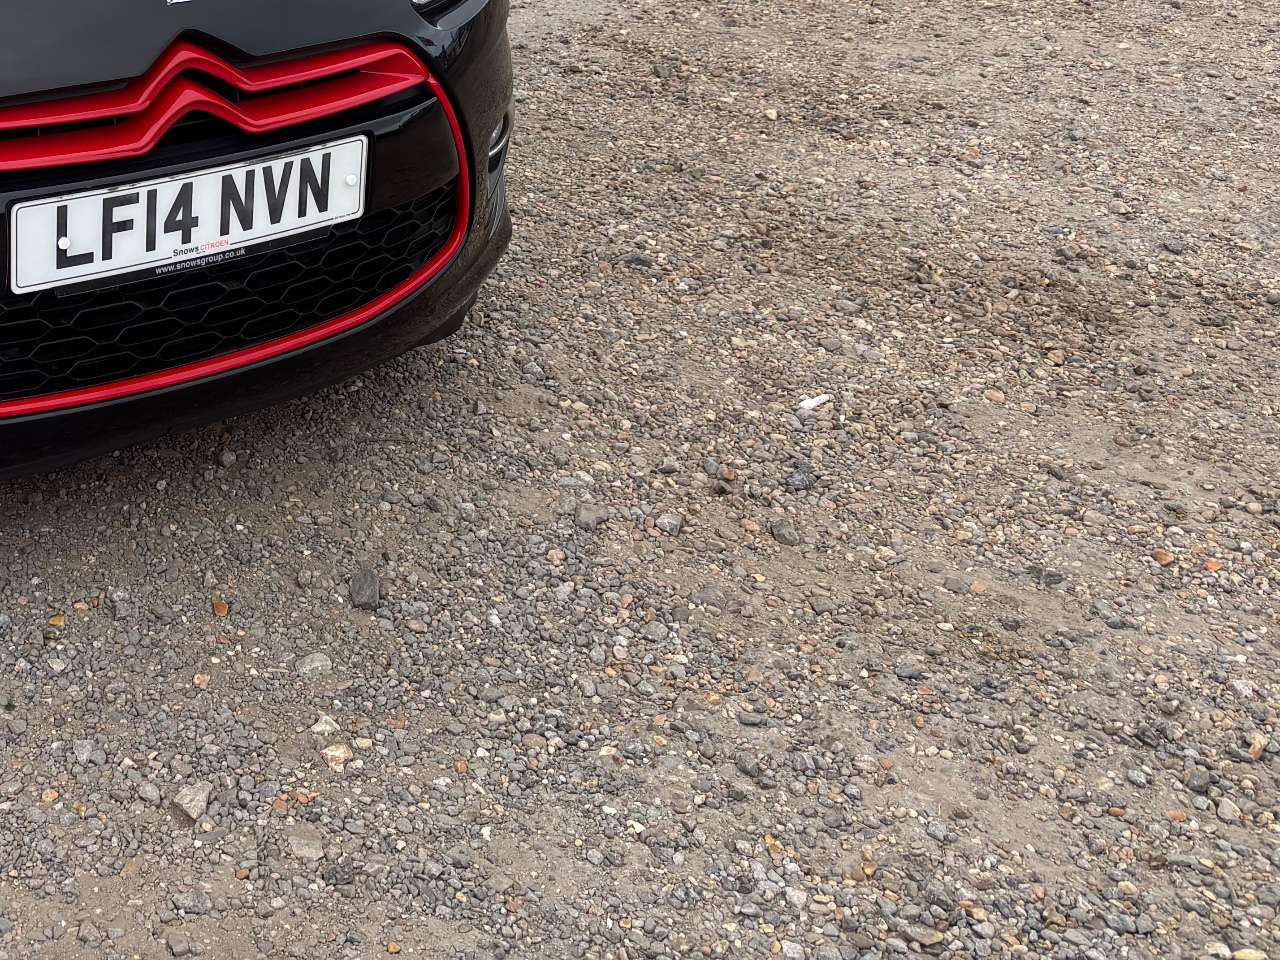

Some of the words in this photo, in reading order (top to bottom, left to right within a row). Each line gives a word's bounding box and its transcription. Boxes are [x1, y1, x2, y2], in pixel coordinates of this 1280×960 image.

[56, 181, 199, 269] LF14
[220, 152, 332, 237] NVN
[155, 247, 246, 275] www.snowsgroup.co.uk
[173, 246, 199, 257] Snows
